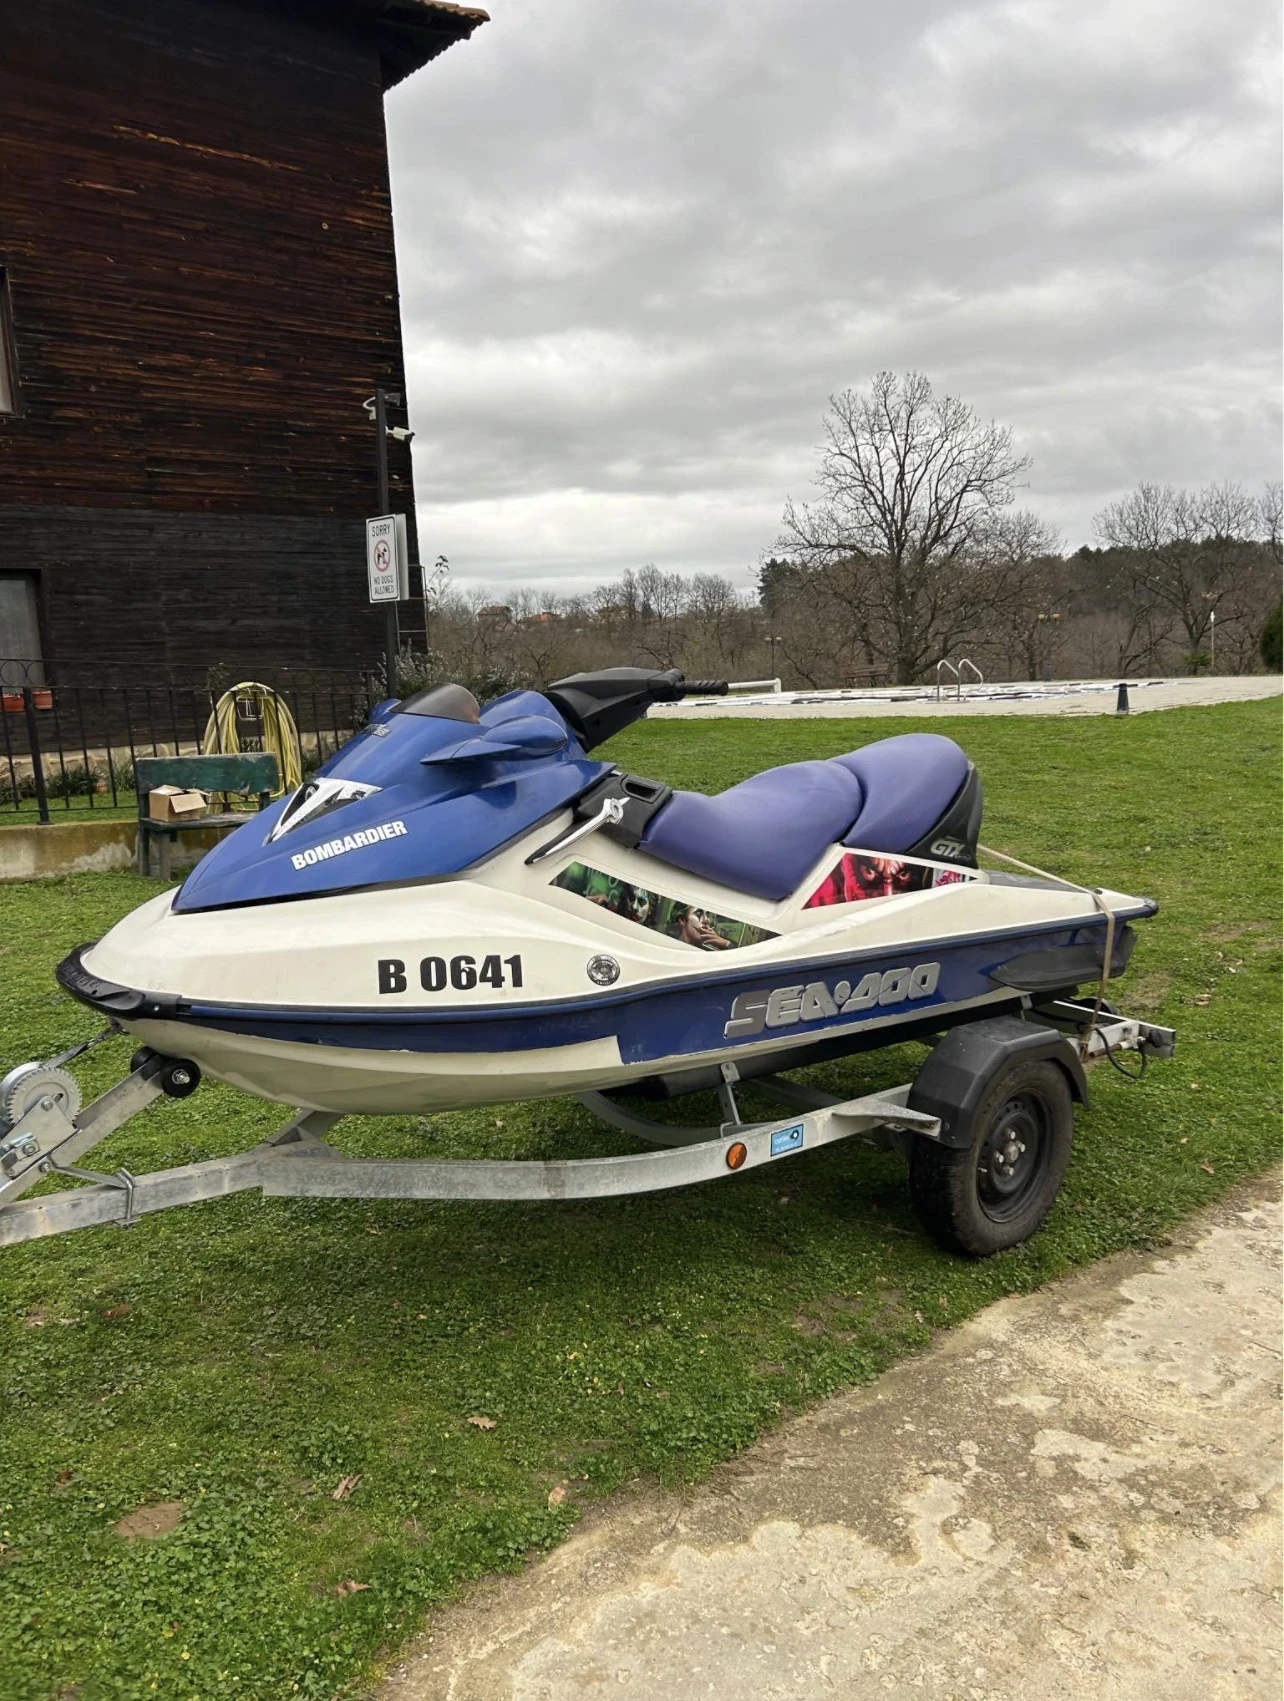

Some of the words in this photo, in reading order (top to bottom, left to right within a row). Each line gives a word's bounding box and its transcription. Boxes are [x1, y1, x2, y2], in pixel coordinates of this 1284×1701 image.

[371, 524, 390, 537] SORRY
[291, 820, 408, 870] BOMBARDIER
[931, 839, 966, 858] GTX
[378, 959, 407, 994] B
[420, 954, 523, 992] 0641
